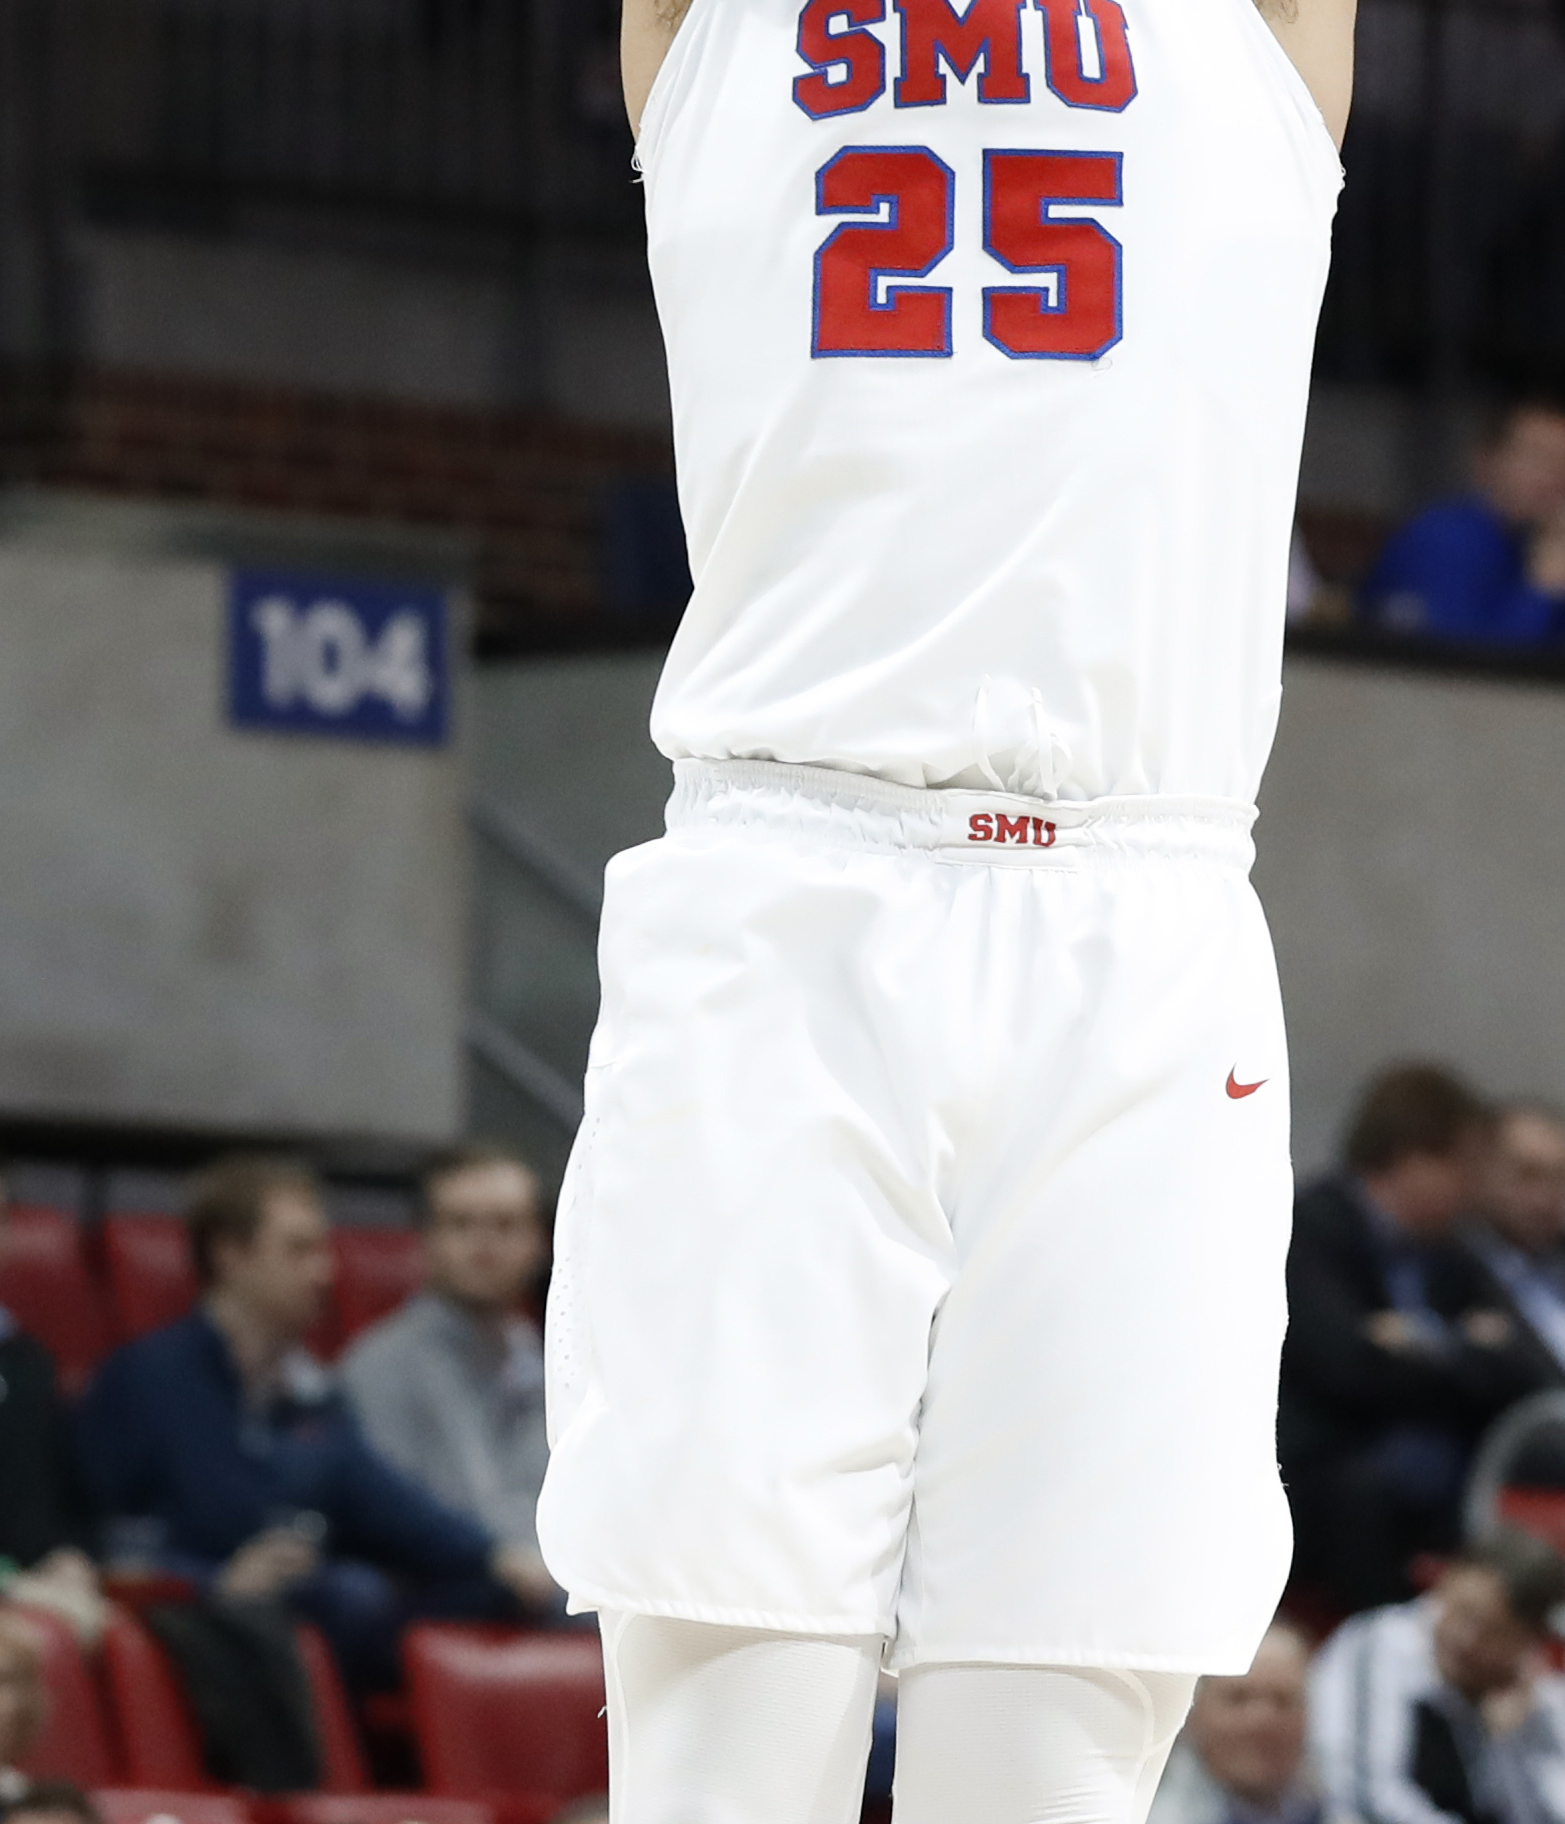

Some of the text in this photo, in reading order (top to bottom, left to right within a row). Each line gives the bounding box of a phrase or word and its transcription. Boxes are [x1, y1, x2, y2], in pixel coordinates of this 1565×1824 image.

[810, 144, 1124, 361] 25
[248, 593, 431, 723] 104
[967, 812, 1057, 848] SMU
